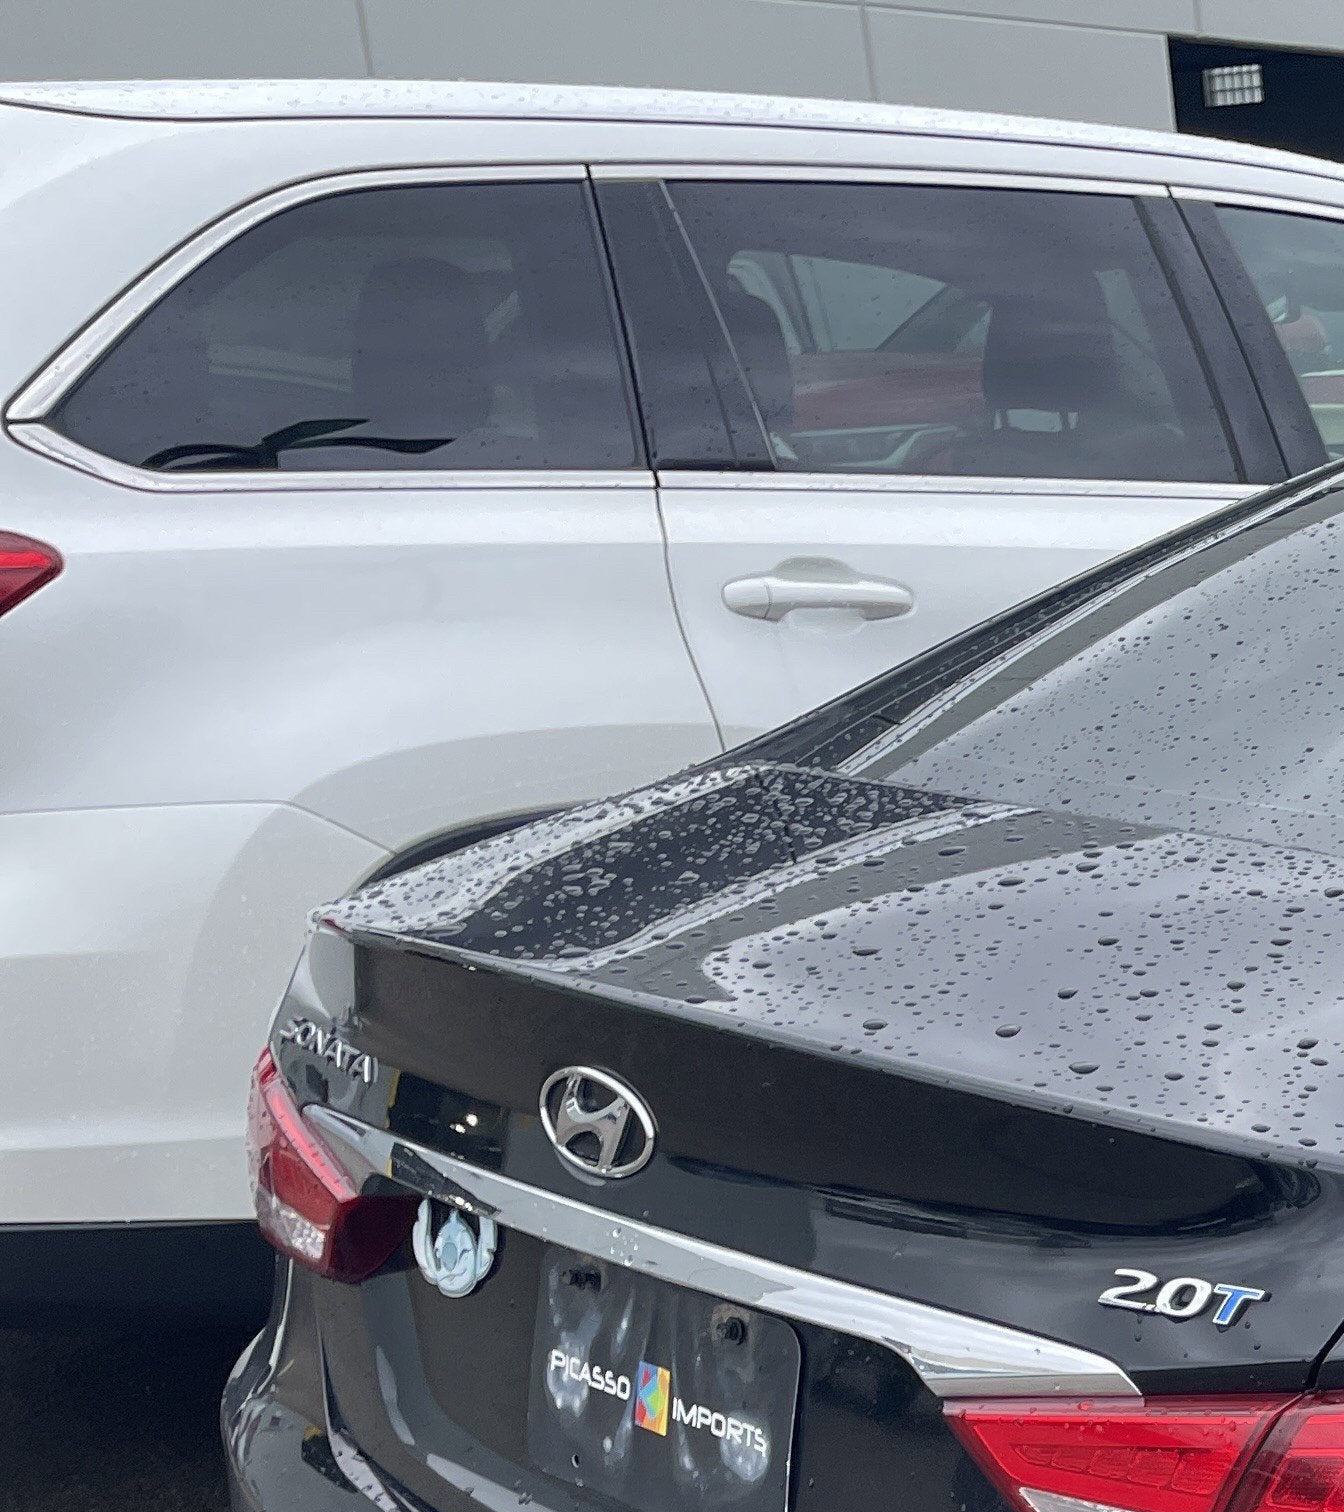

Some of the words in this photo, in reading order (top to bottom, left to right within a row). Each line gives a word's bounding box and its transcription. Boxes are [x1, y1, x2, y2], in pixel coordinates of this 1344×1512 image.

[280, 1018, 371, 1083] SONATA
[550, 1349, 631, 1401] PICASSO
[672, 1396, 768, 1457] IMPORTS
